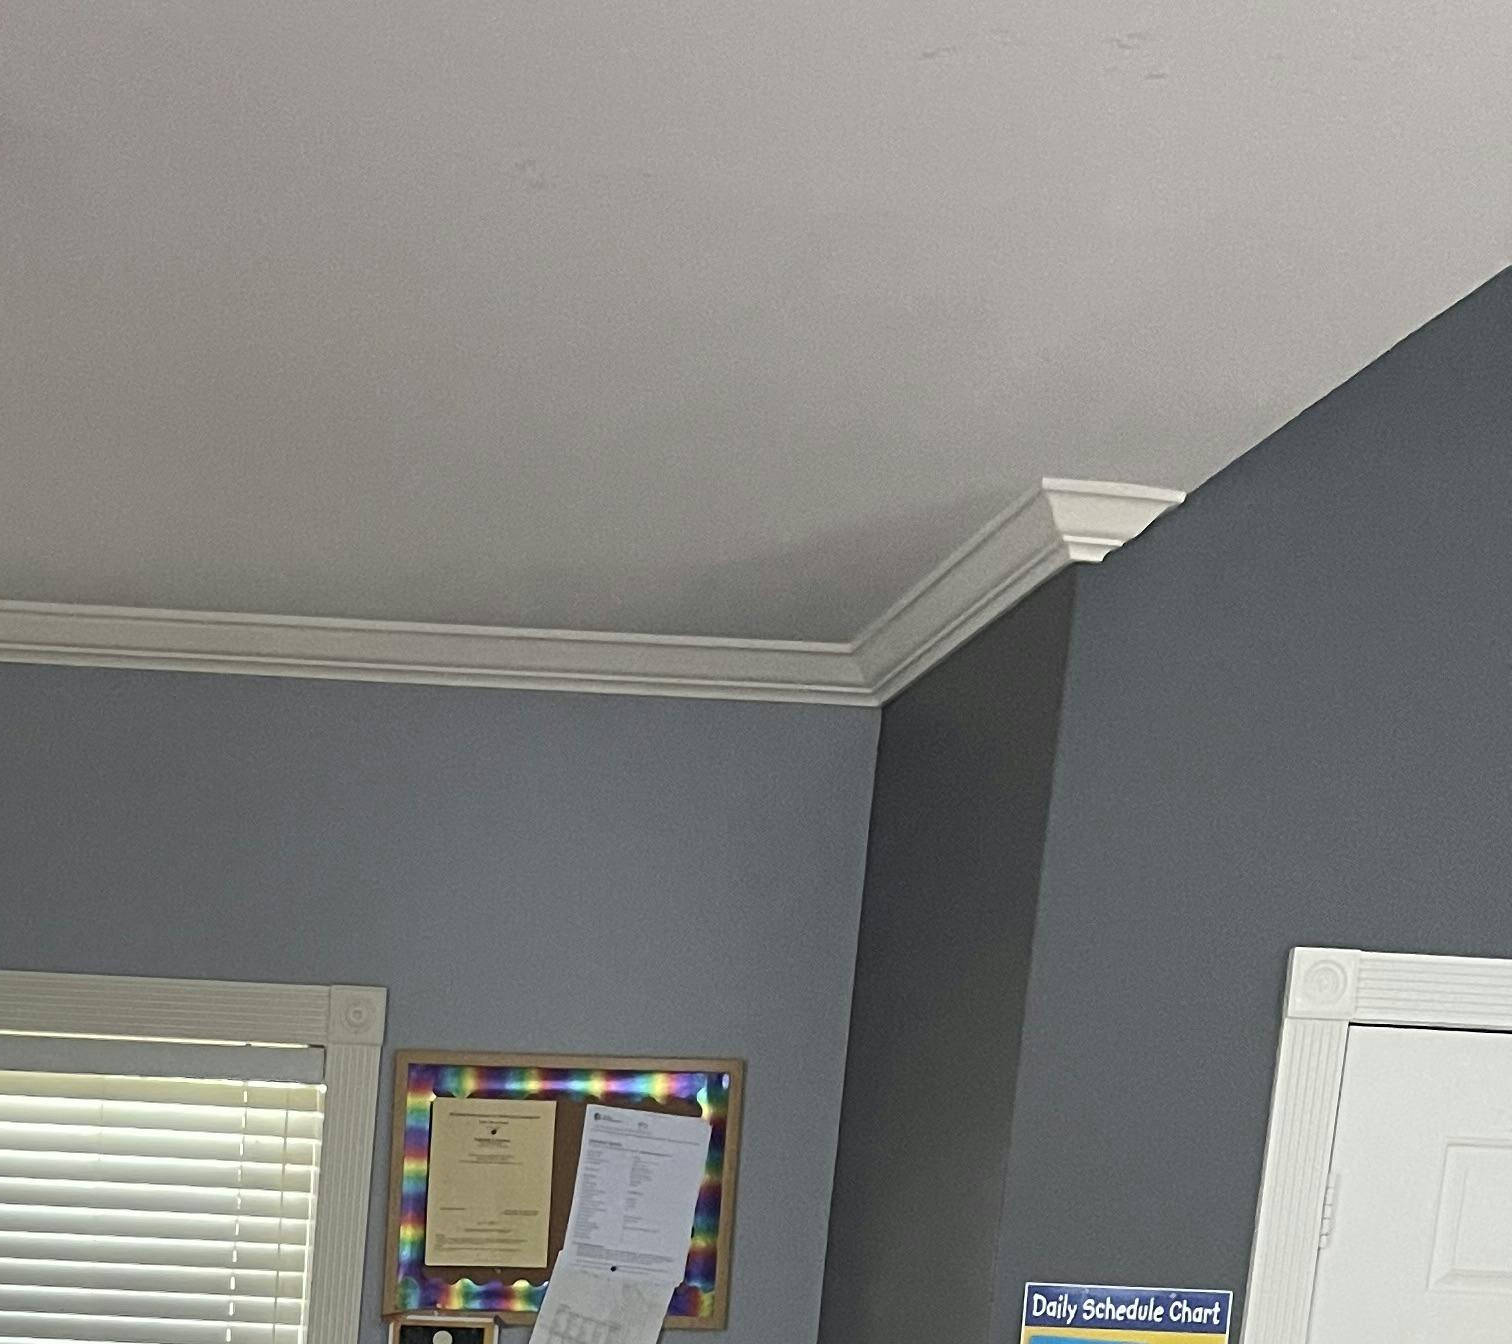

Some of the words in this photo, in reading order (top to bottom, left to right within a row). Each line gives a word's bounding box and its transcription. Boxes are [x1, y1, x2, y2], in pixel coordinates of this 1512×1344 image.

[1032, 1294, 1078, 1324] Daily
[1082, 1298, 1164, 1323] Schedule
[1169, 1301, 1221, 1326] Chart
